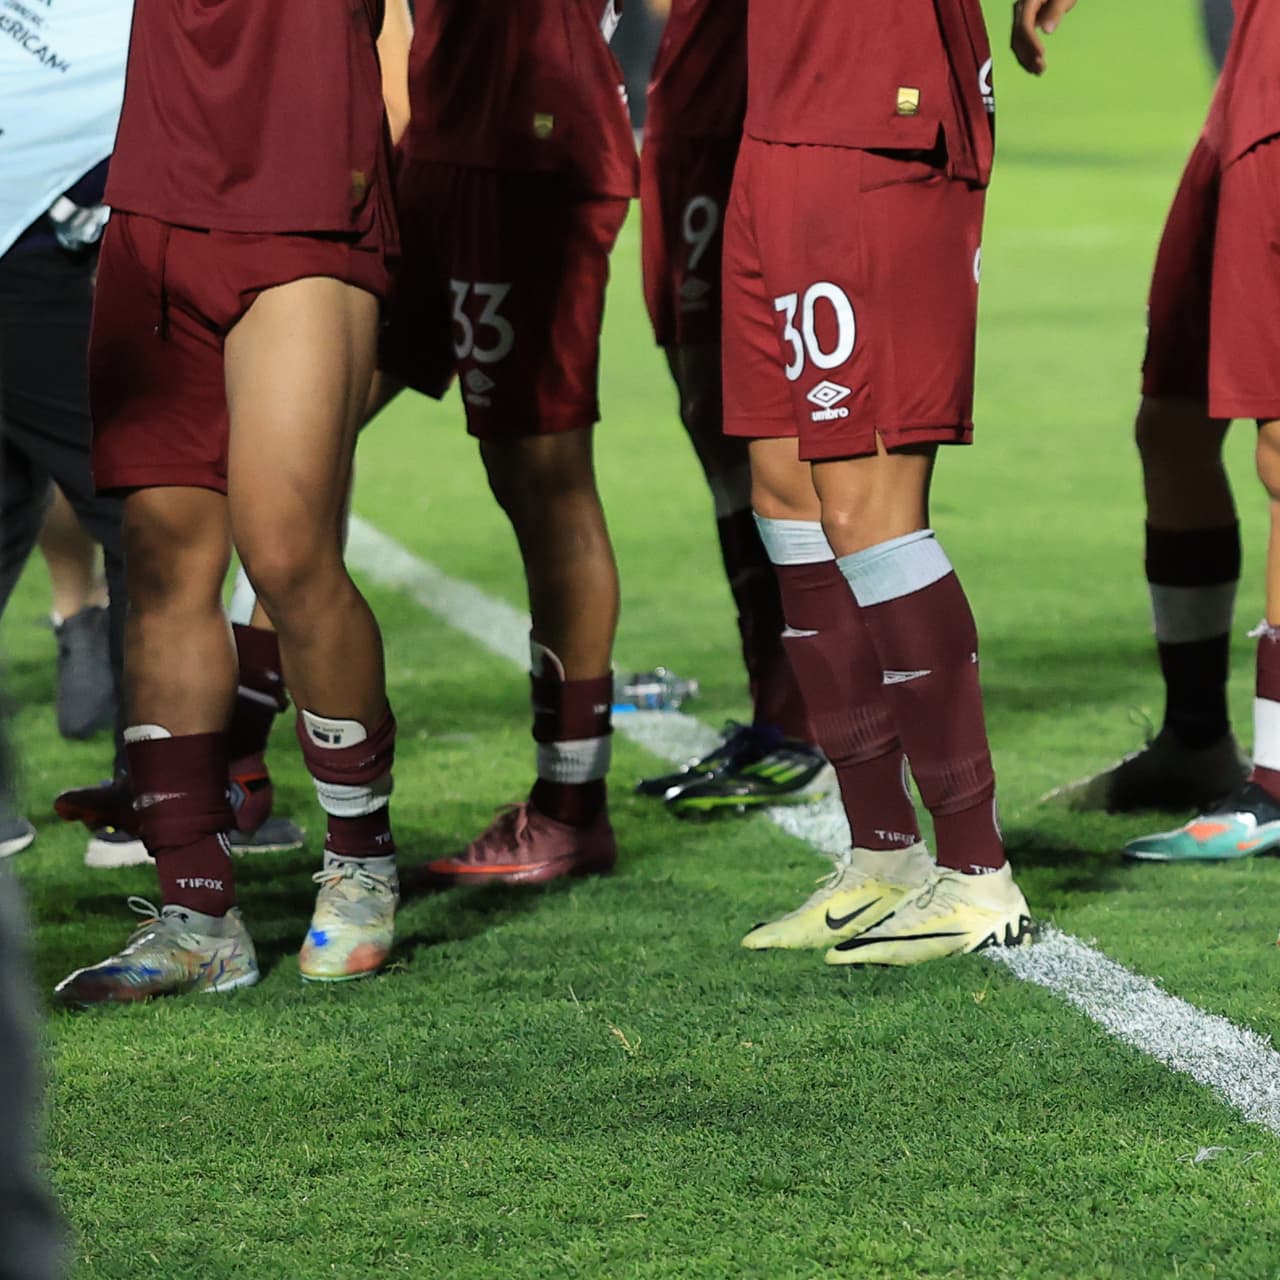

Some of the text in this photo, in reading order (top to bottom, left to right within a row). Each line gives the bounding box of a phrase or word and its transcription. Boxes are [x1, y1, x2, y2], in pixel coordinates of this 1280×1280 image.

[682, 196, 718, 270] 9
[450, 280, 514, 362] 33
[774, 281, 856, 381] 30
[176, 877, 224, 892] TIFOX
